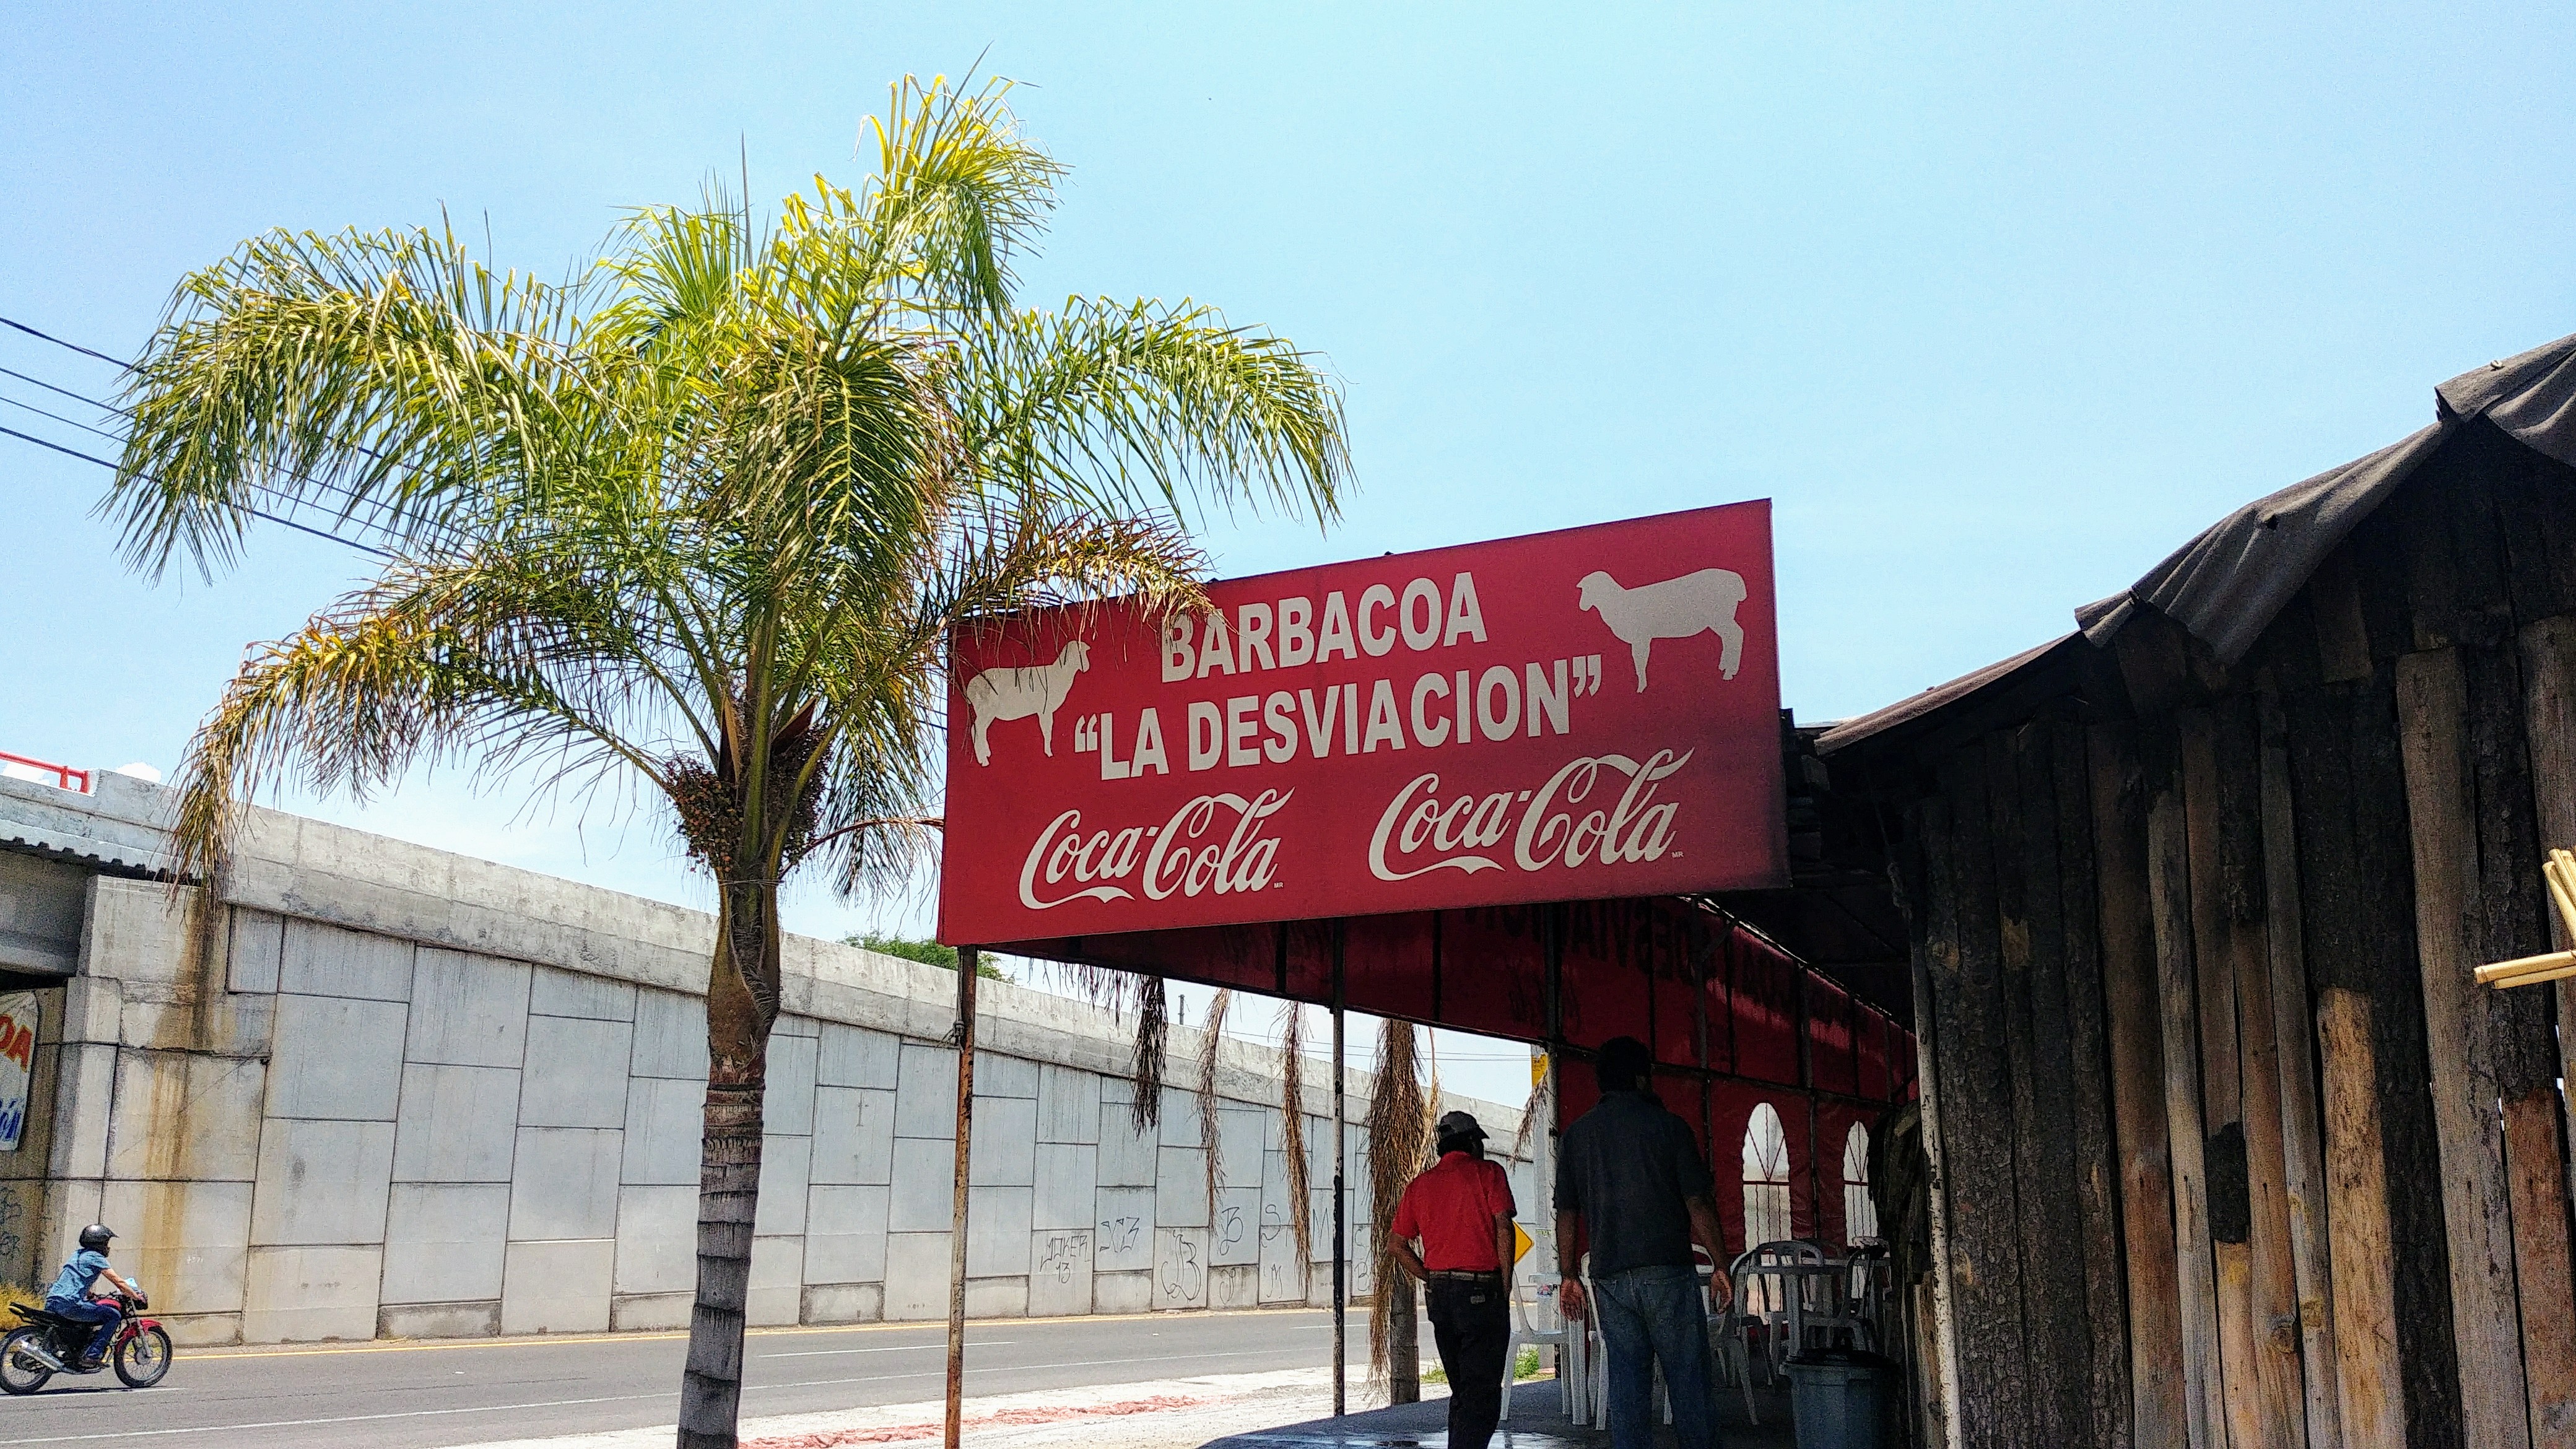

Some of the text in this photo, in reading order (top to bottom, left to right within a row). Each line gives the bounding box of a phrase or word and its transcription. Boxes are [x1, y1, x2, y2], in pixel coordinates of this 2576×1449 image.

[1160, 571, 1488, 683] BARBACOA
[1019, 786, 1295, 910] Coca-Cola
[1368, 747, 1695, 882] Coca-Cola
[1039, 1234, 1092, 1273] JOKER
